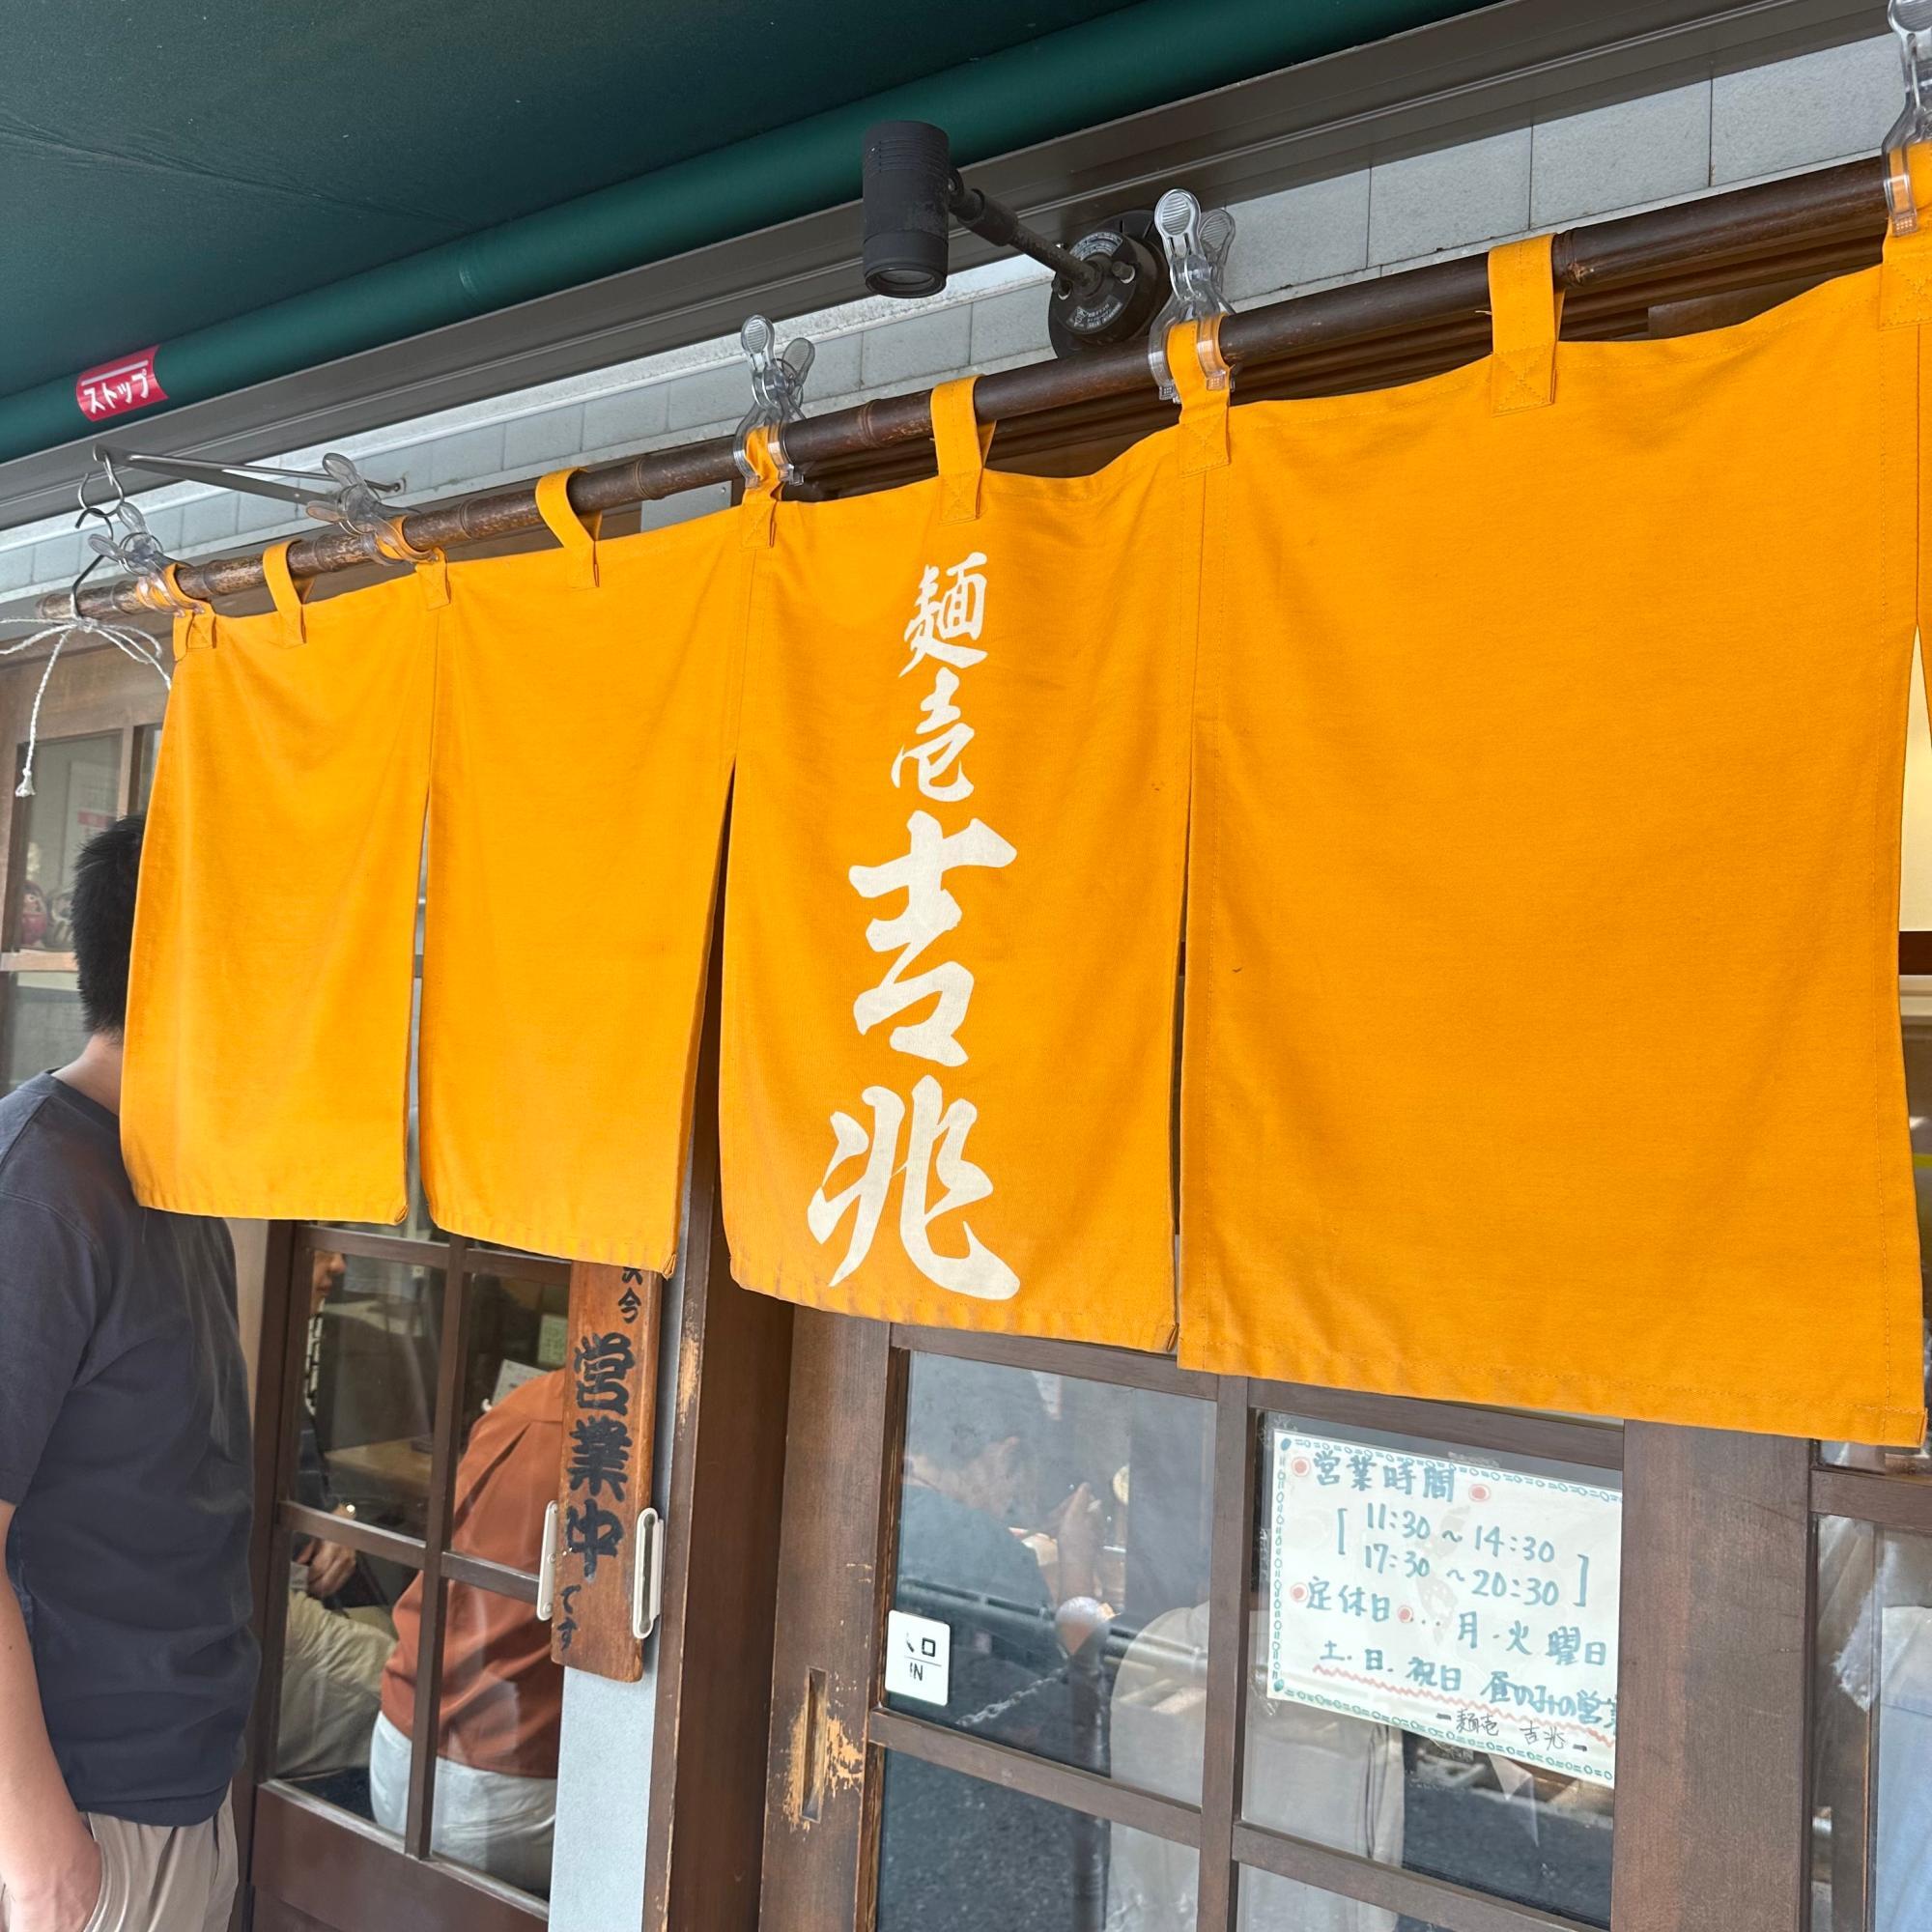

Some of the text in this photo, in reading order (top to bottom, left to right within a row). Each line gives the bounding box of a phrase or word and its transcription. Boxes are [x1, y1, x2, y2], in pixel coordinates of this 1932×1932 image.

[83, 368, 150, 413] ストップ
[1313, 1451, 1456, 1503] 営業時間
[559, 1584, 582, 1650] です
[909, 1662, 923, 1682] IN
